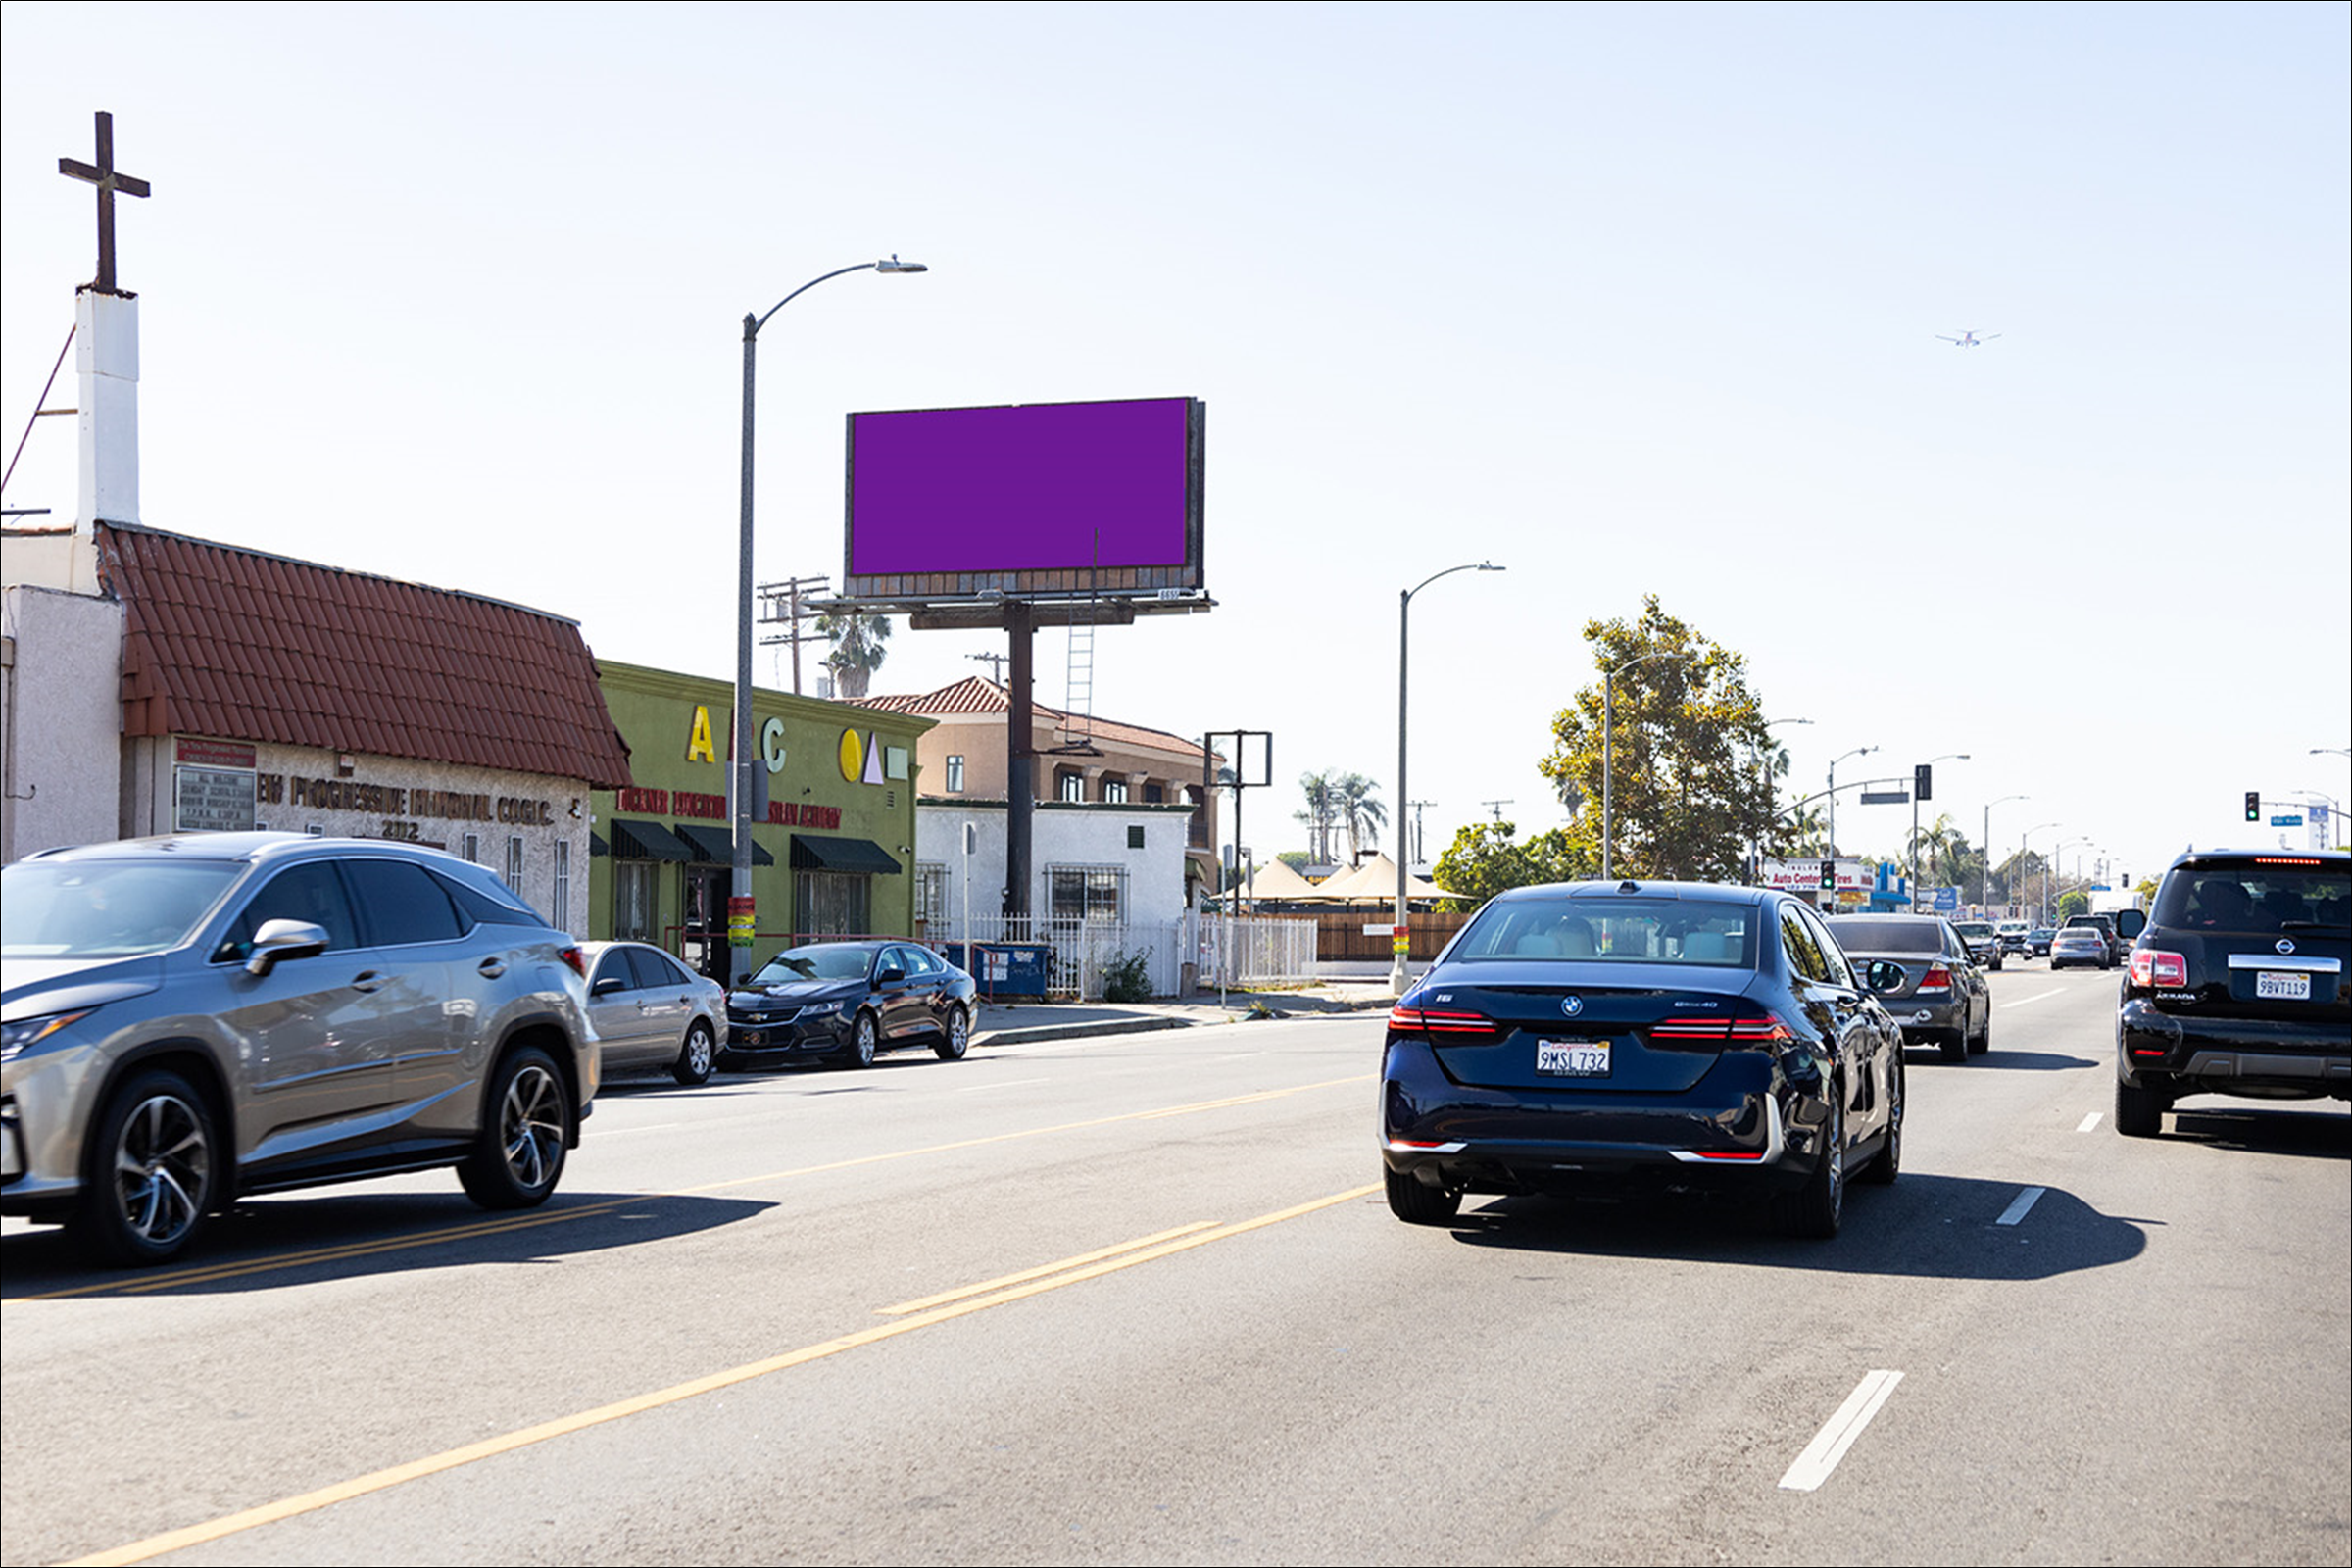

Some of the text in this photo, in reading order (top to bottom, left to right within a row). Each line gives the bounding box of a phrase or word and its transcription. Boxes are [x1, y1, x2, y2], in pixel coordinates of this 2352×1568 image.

[257, 772, 283, 804] EW
[291, 776, 406, 815] PROGRESSIVE
[672, 791, 727, 820] EDUCATIO
[1773, 873, 1792, 884] Auto
[1793, 873, 1821, 884] Center
[1834, 874, 1852, 884] Tires
[2260, 981, 2308, 995] 9BVT119
[1541, 1052, 1607, 1070] 9MSL732
